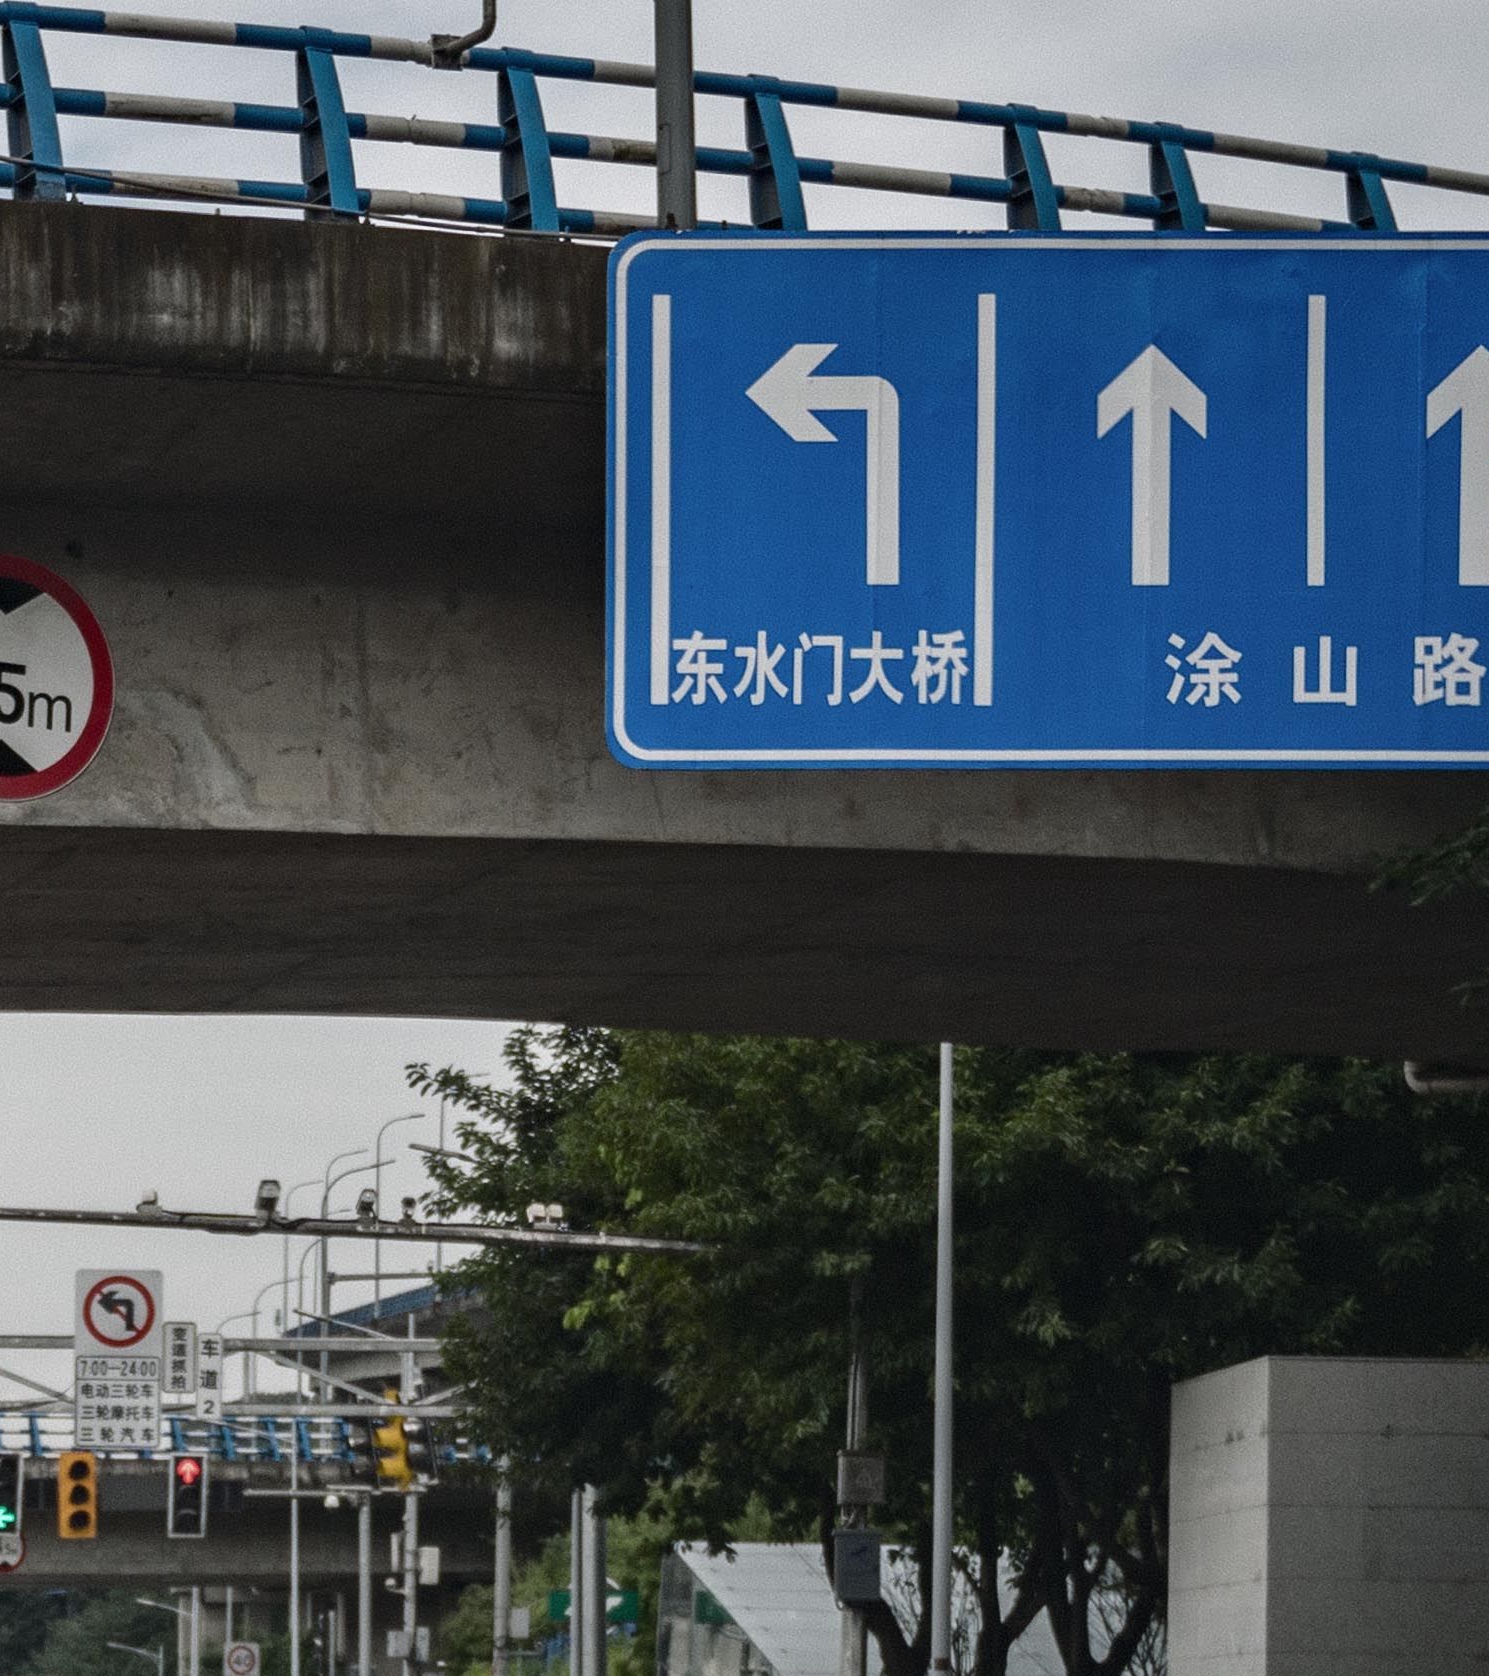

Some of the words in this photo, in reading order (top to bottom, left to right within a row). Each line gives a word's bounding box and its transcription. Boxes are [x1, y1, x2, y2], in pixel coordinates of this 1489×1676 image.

[671, 630, 970, 707] 东水门大桥
[1164, 632, 1487, 709] 涂山路
[81, 1383, 153, 1399] 电动三轮车
[82, 1405, 154, 1421] 三轮摩托车
[81, 1427, 154, 1442] 三轮汽车
